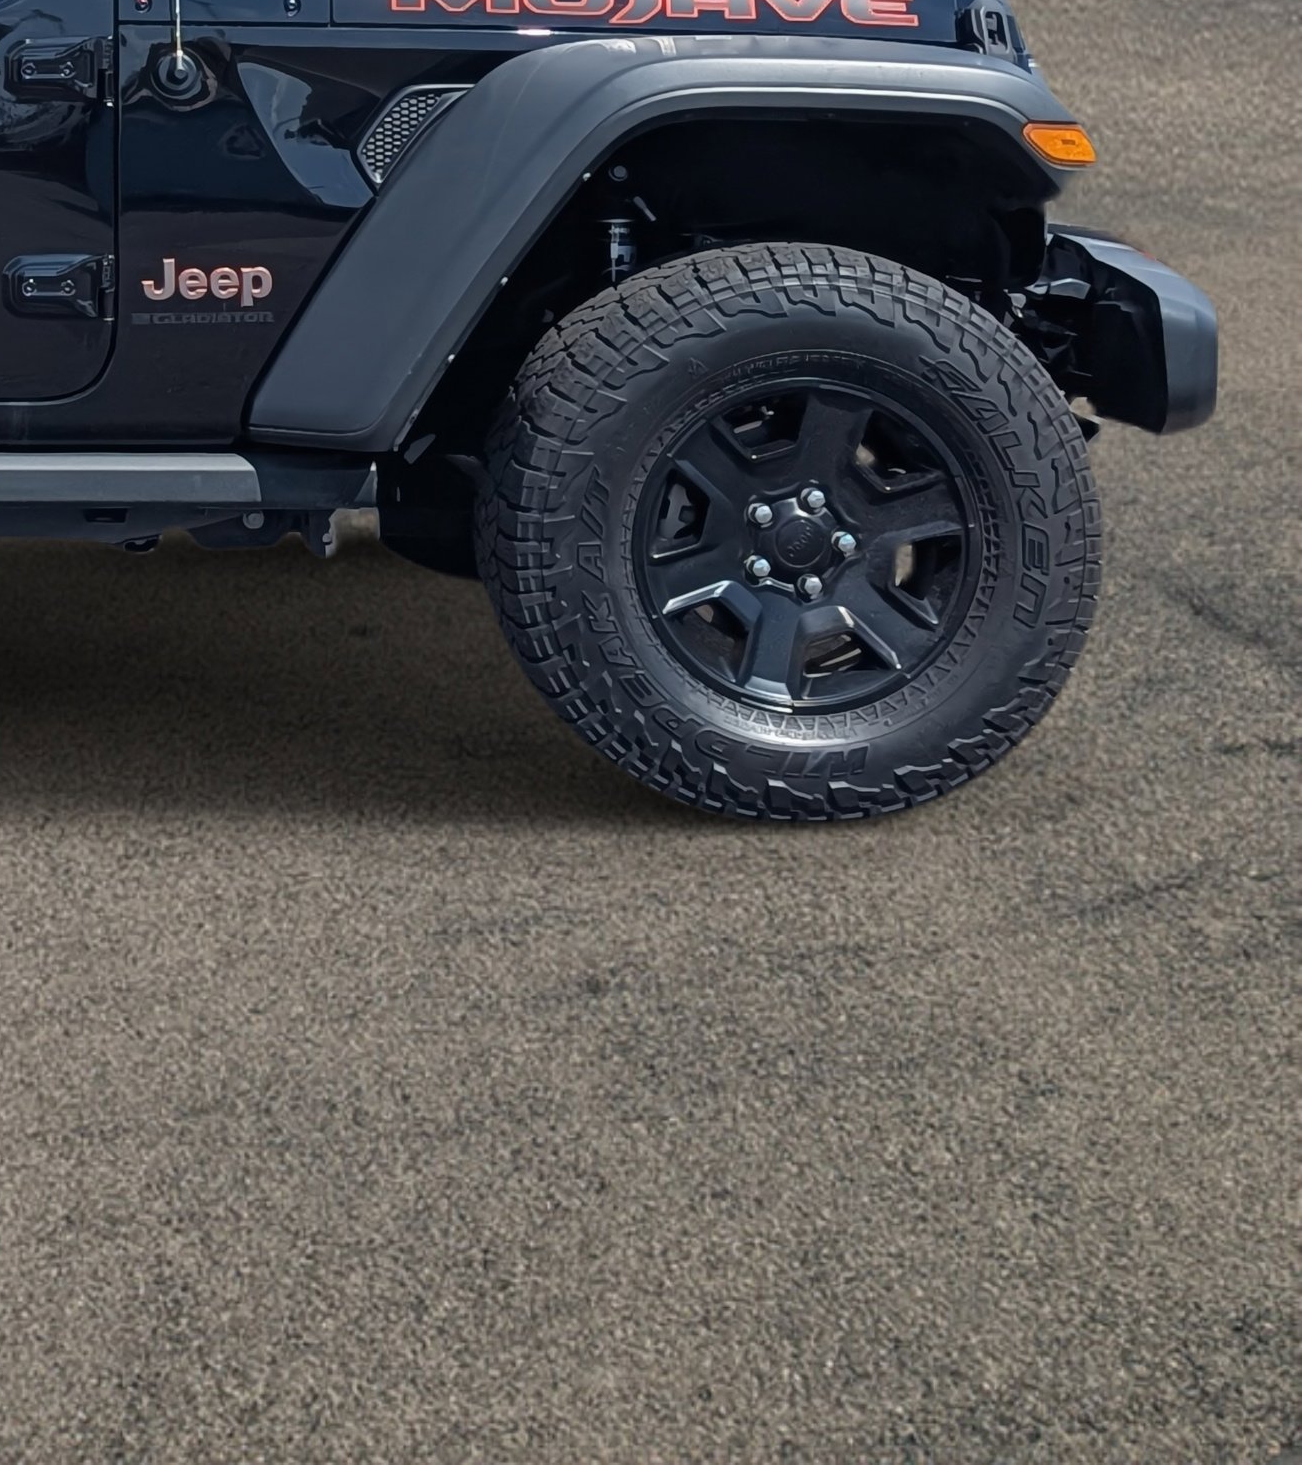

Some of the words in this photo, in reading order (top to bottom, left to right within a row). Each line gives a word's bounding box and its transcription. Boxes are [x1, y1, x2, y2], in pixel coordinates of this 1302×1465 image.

[141, 258, 273, 307] Jeep
[152, 311, 275, 325] GLADIATOR
[918, 355, 1050, 630] FALKEN
[582, 591, 871, 778] WILDPEAK
